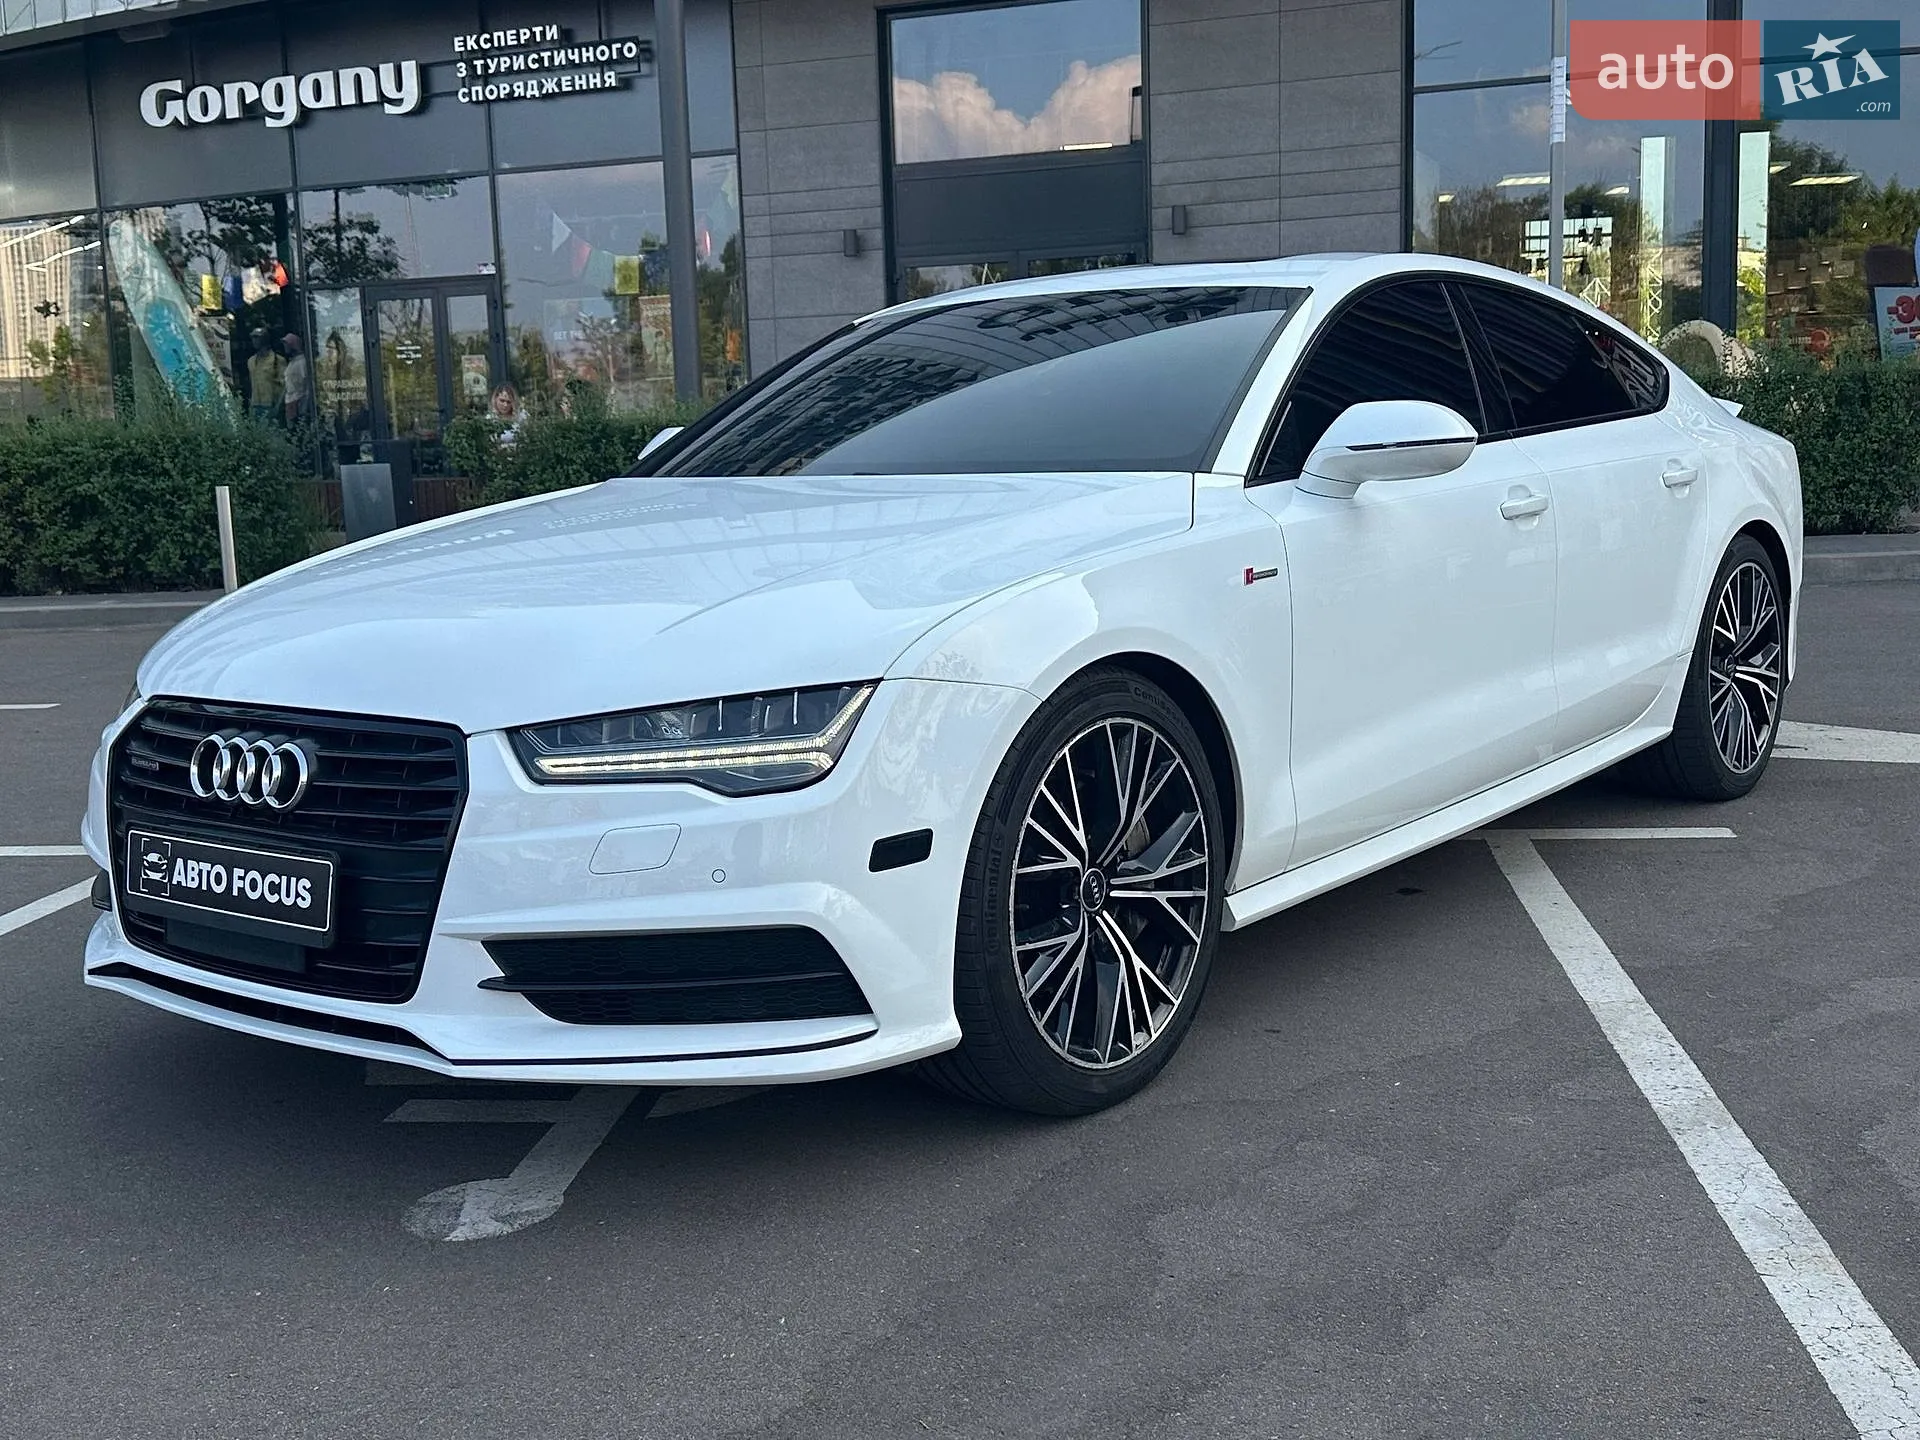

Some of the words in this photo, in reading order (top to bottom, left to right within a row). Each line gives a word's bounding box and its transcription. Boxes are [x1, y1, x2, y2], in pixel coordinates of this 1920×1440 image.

[453, 24, 559, 52] ЕКСПЕРТИ
[456, 62, 467, 78] З
[473, 41, 638, 75] ТУРИСТИЧНОГО
[139, 59, 418, 128] Gorgany
[457, 71, 617, 104] СПОРЯДЖЕННЯ
[171, 857, 228, 894] АВТО
[232, 867, 312, 909] FOCUS
